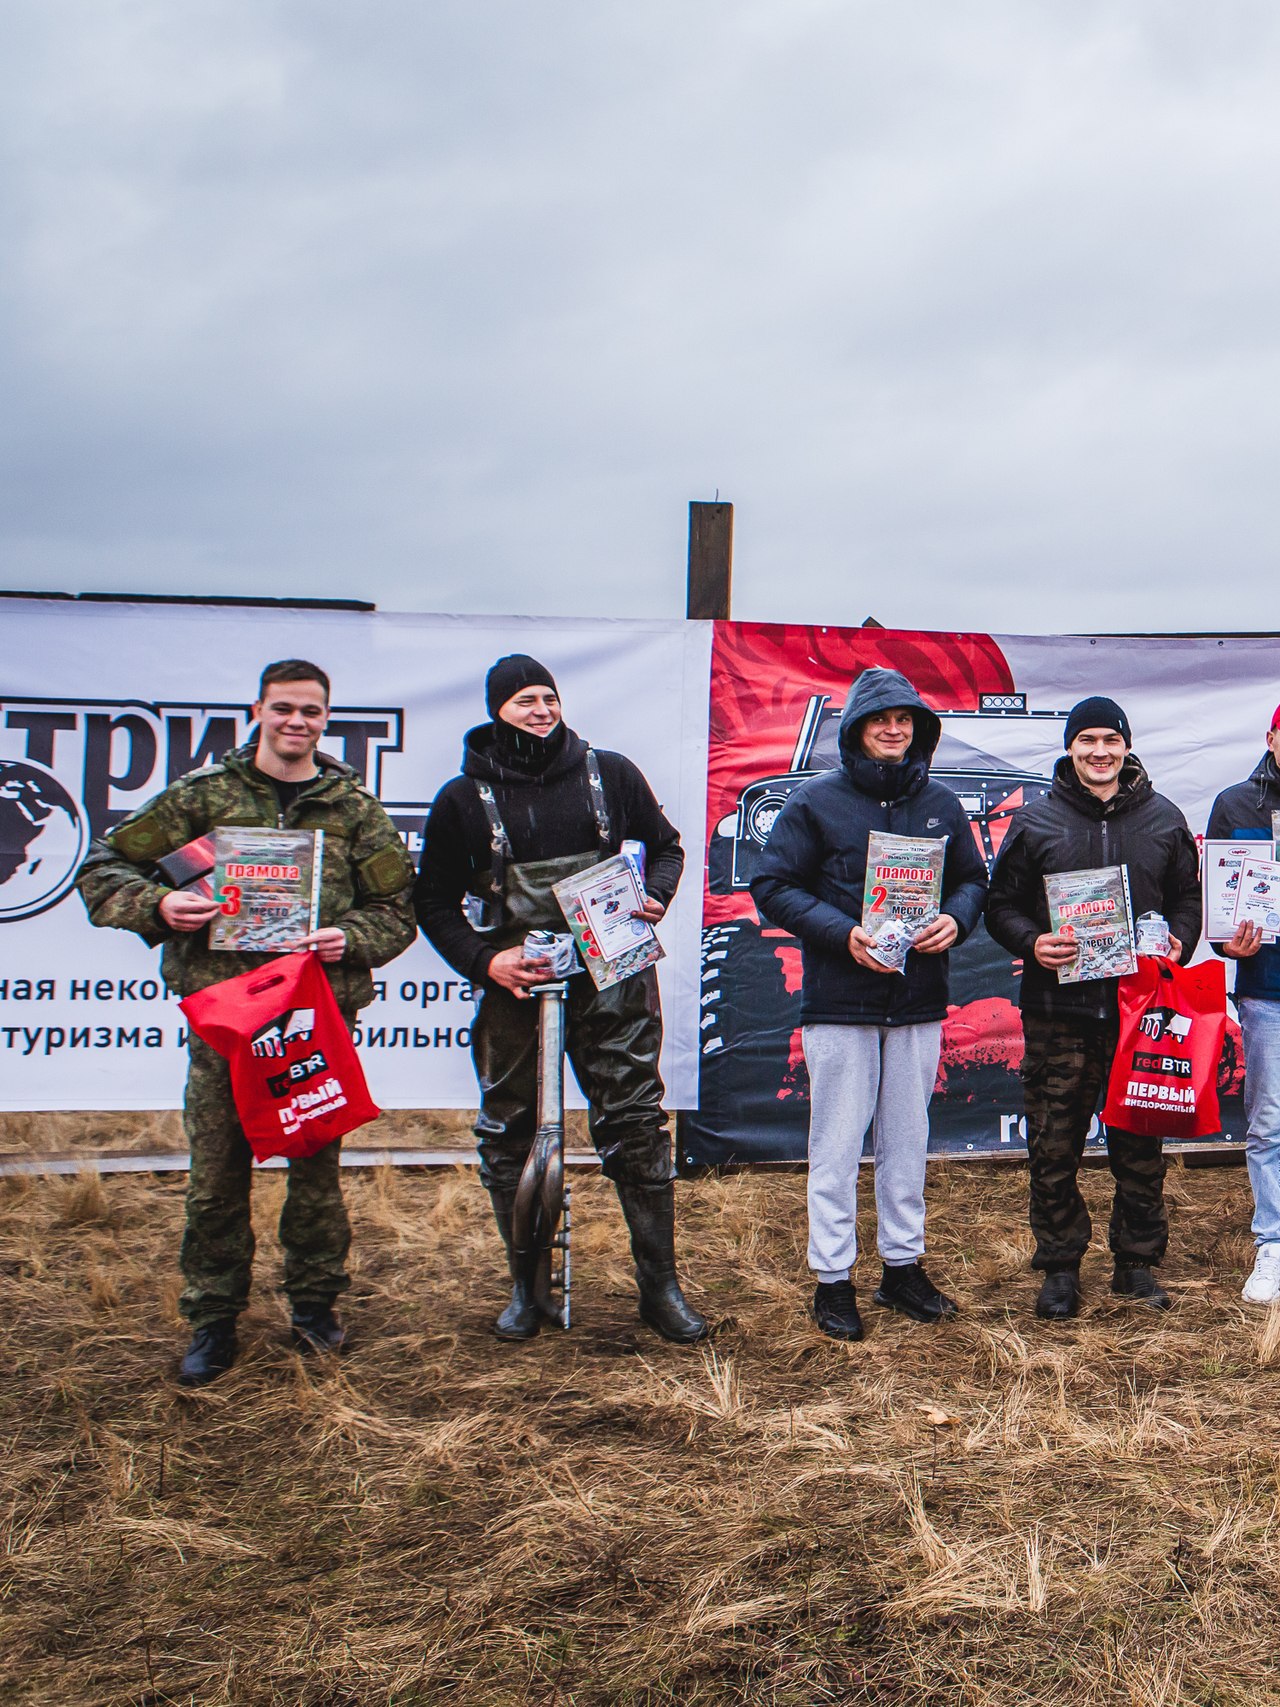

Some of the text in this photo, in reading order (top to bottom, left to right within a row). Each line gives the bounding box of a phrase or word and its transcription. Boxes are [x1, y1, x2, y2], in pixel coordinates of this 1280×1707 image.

[226, 864, 299, 879] грамота
[876, 866, 934, 881] грамота
[220, 885, 242, 917] 3
[870, 886, 888, 914] 2
[1058, 899, 1116, 918] грамота
[249, 907, 289, 918] место
[892, 906, 924, 916] место
[1, 1027, 163, 1056] туризма
[1136, 1056, 1191, 1074] redBTR
[1126, 1081, 1195, 1104] ПЕРВЫЙ
[1124, 1097, 1196, 1114] ВНЕДОРОЖНЫЙ
